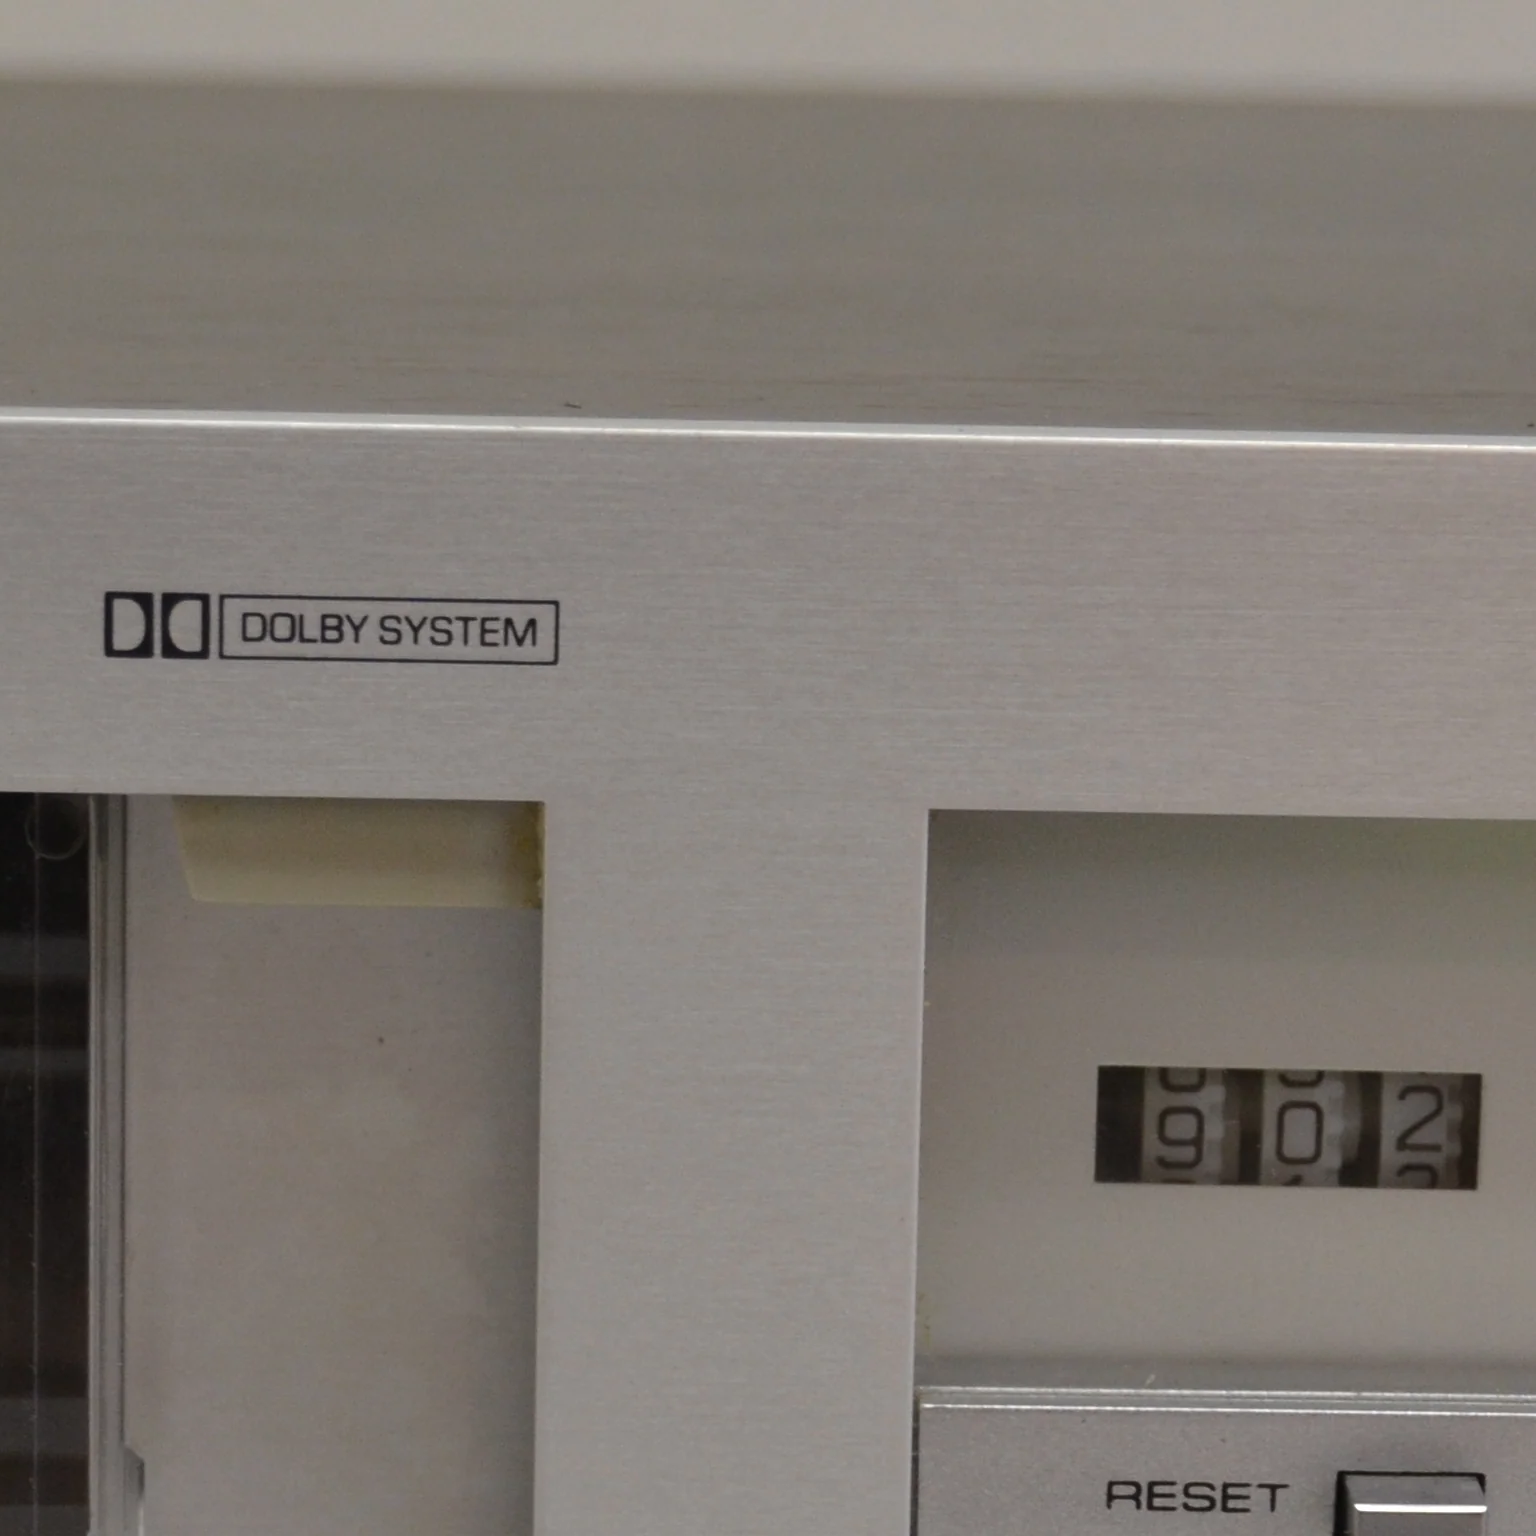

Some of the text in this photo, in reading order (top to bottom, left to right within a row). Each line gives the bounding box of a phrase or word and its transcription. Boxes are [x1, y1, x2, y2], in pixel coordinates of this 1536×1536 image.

[241, 611, 538, 648] DOLBY SYSTEM
[1105, 1480, 1290, 1514] RESET
